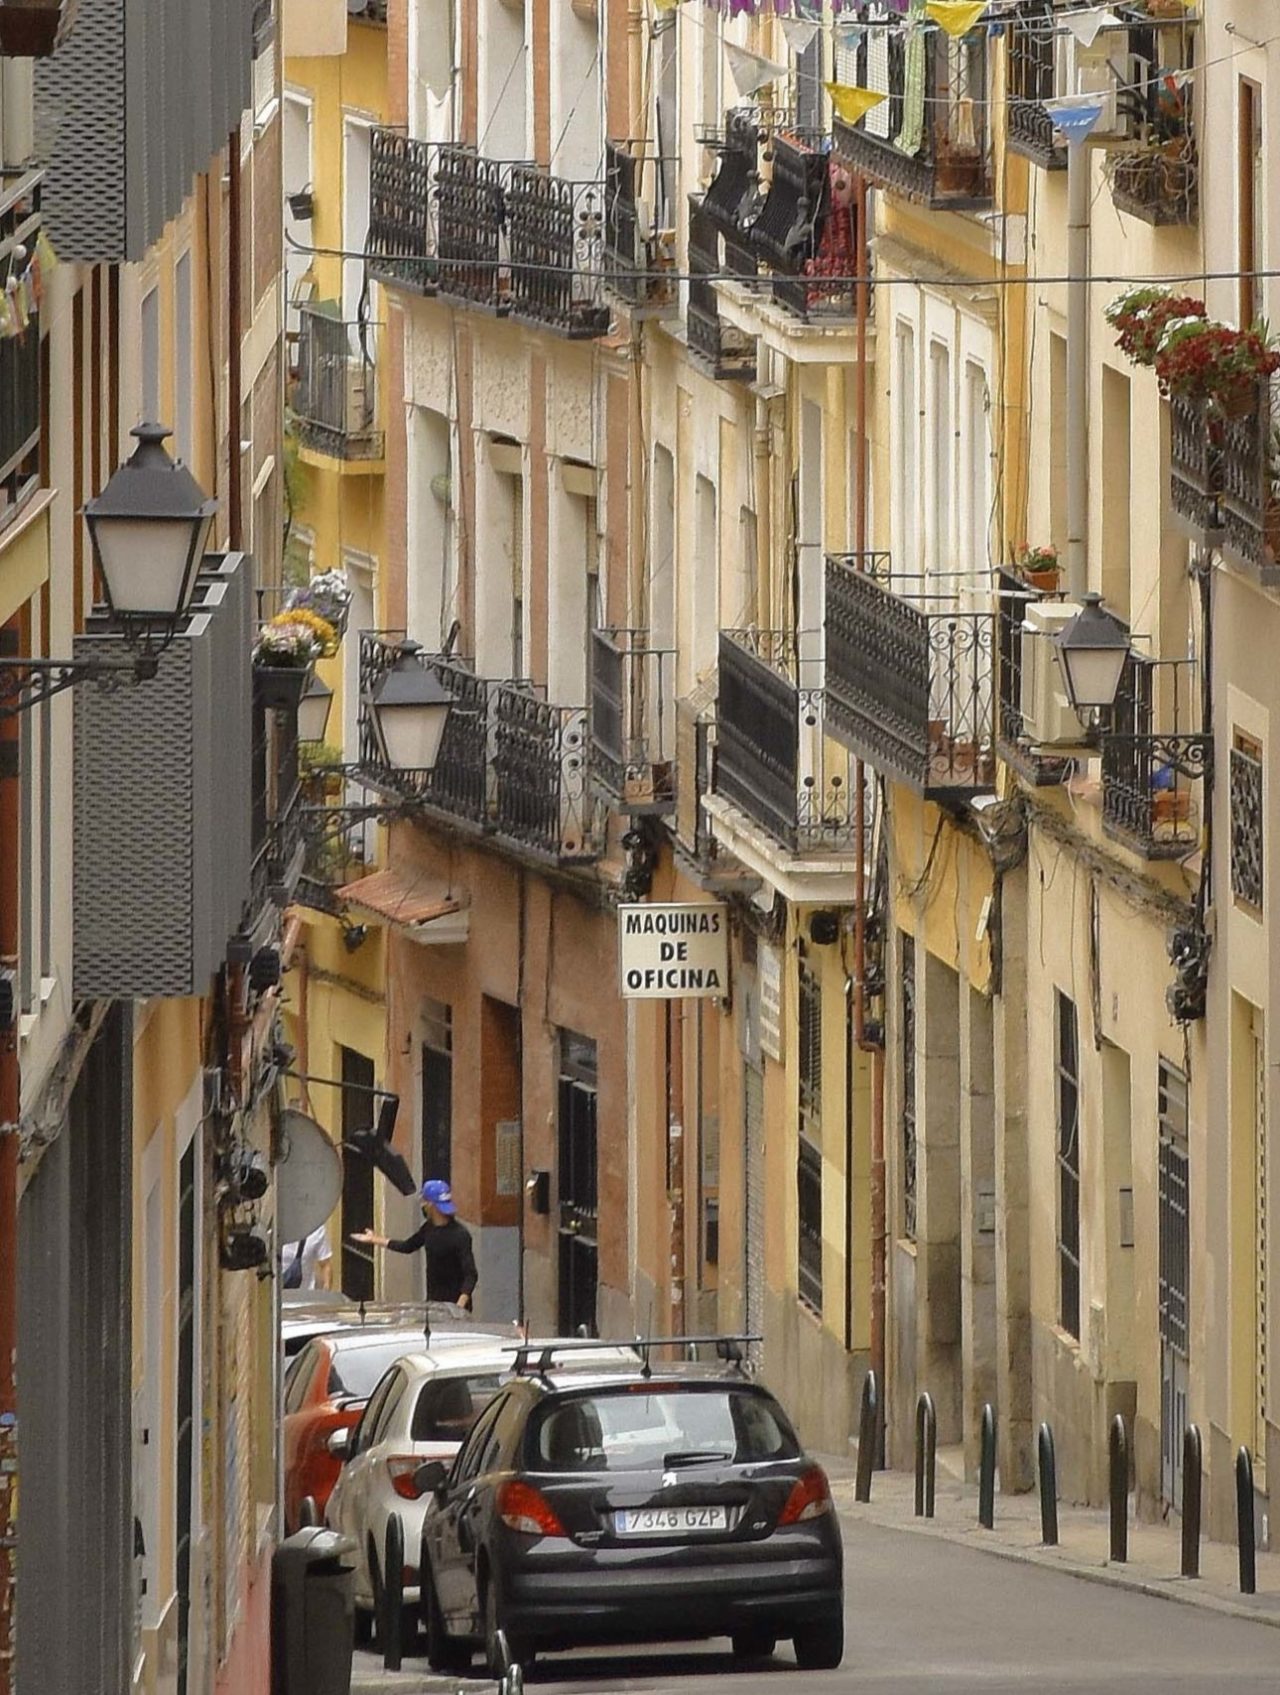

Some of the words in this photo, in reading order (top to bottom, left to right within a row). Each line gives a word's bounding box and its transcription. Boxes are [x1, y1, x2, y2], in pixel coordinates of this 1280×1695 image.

[626, 913, 720, 935] MAQUINAS
[660, 942, 688, 962] DE
[627, 969, 721, 989] OFICINA
[630, 1510, 678, 1529] 7346
[685, 1508, 720, 1527] GZP
